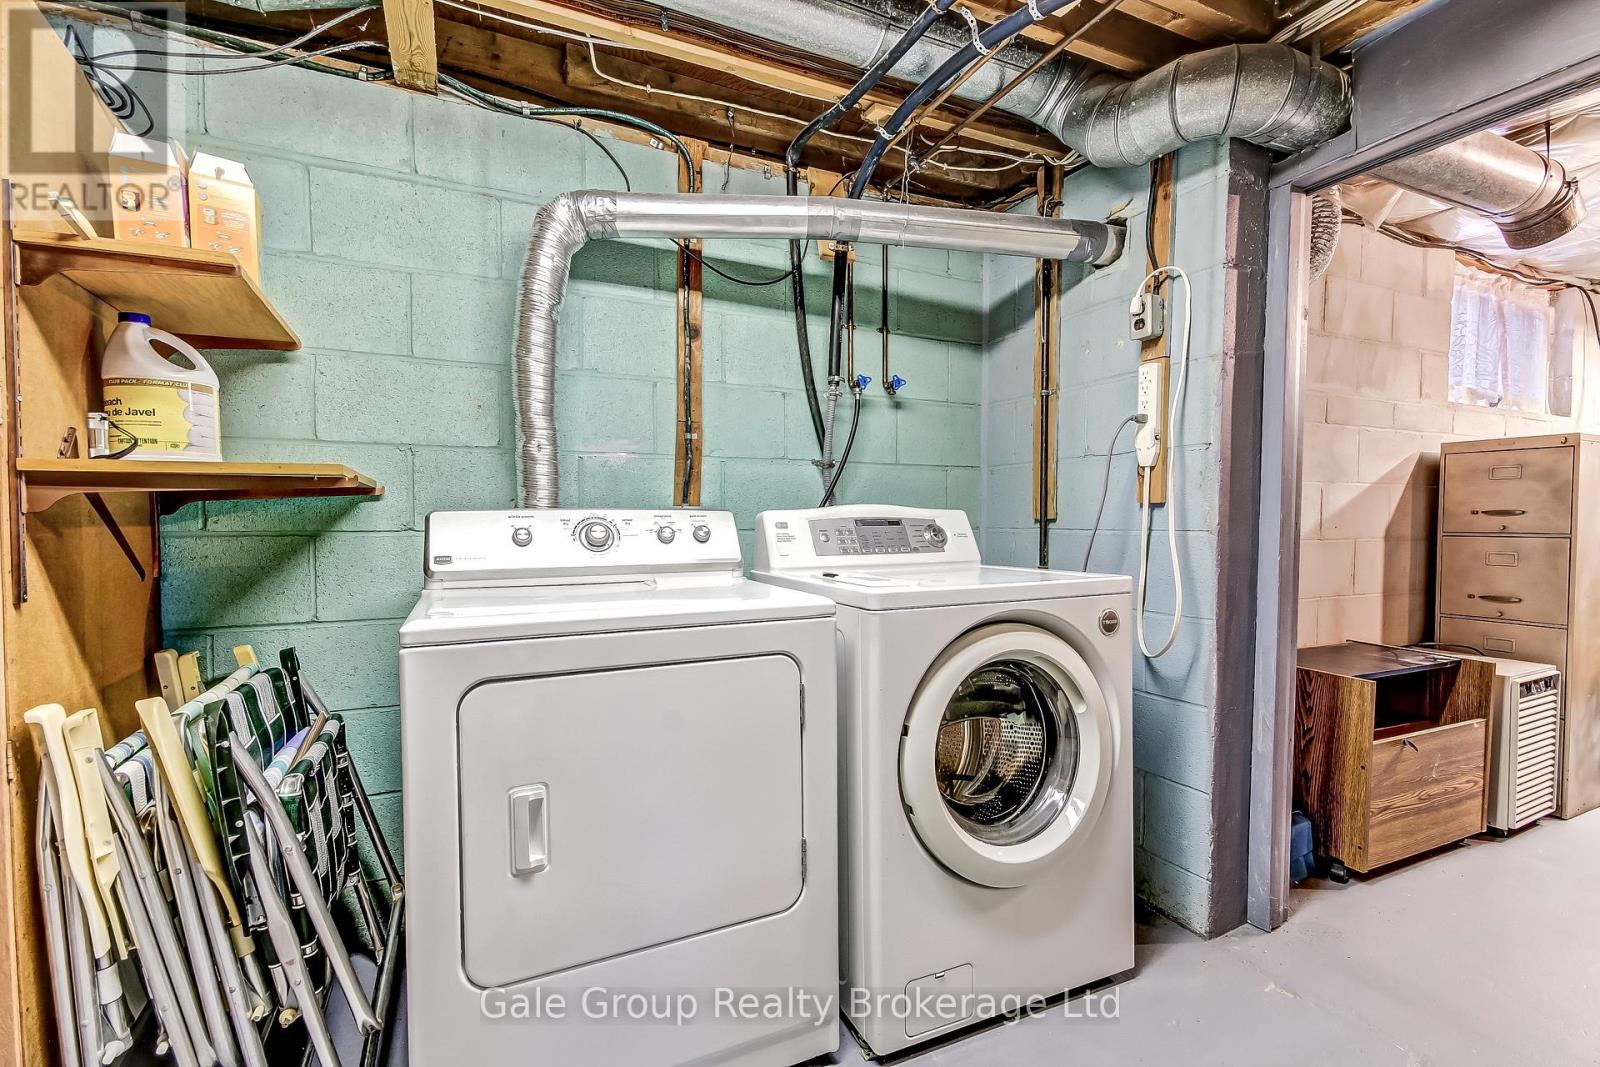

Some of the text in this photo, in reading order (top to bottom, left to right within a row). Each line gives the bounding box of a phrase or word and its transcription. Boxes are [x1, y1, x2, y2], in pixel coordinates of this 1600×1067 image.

[143, 379, 174, 387] FORMAT
[112, 408, 122, 416] de
[125, 408, 156, 416] Javel
